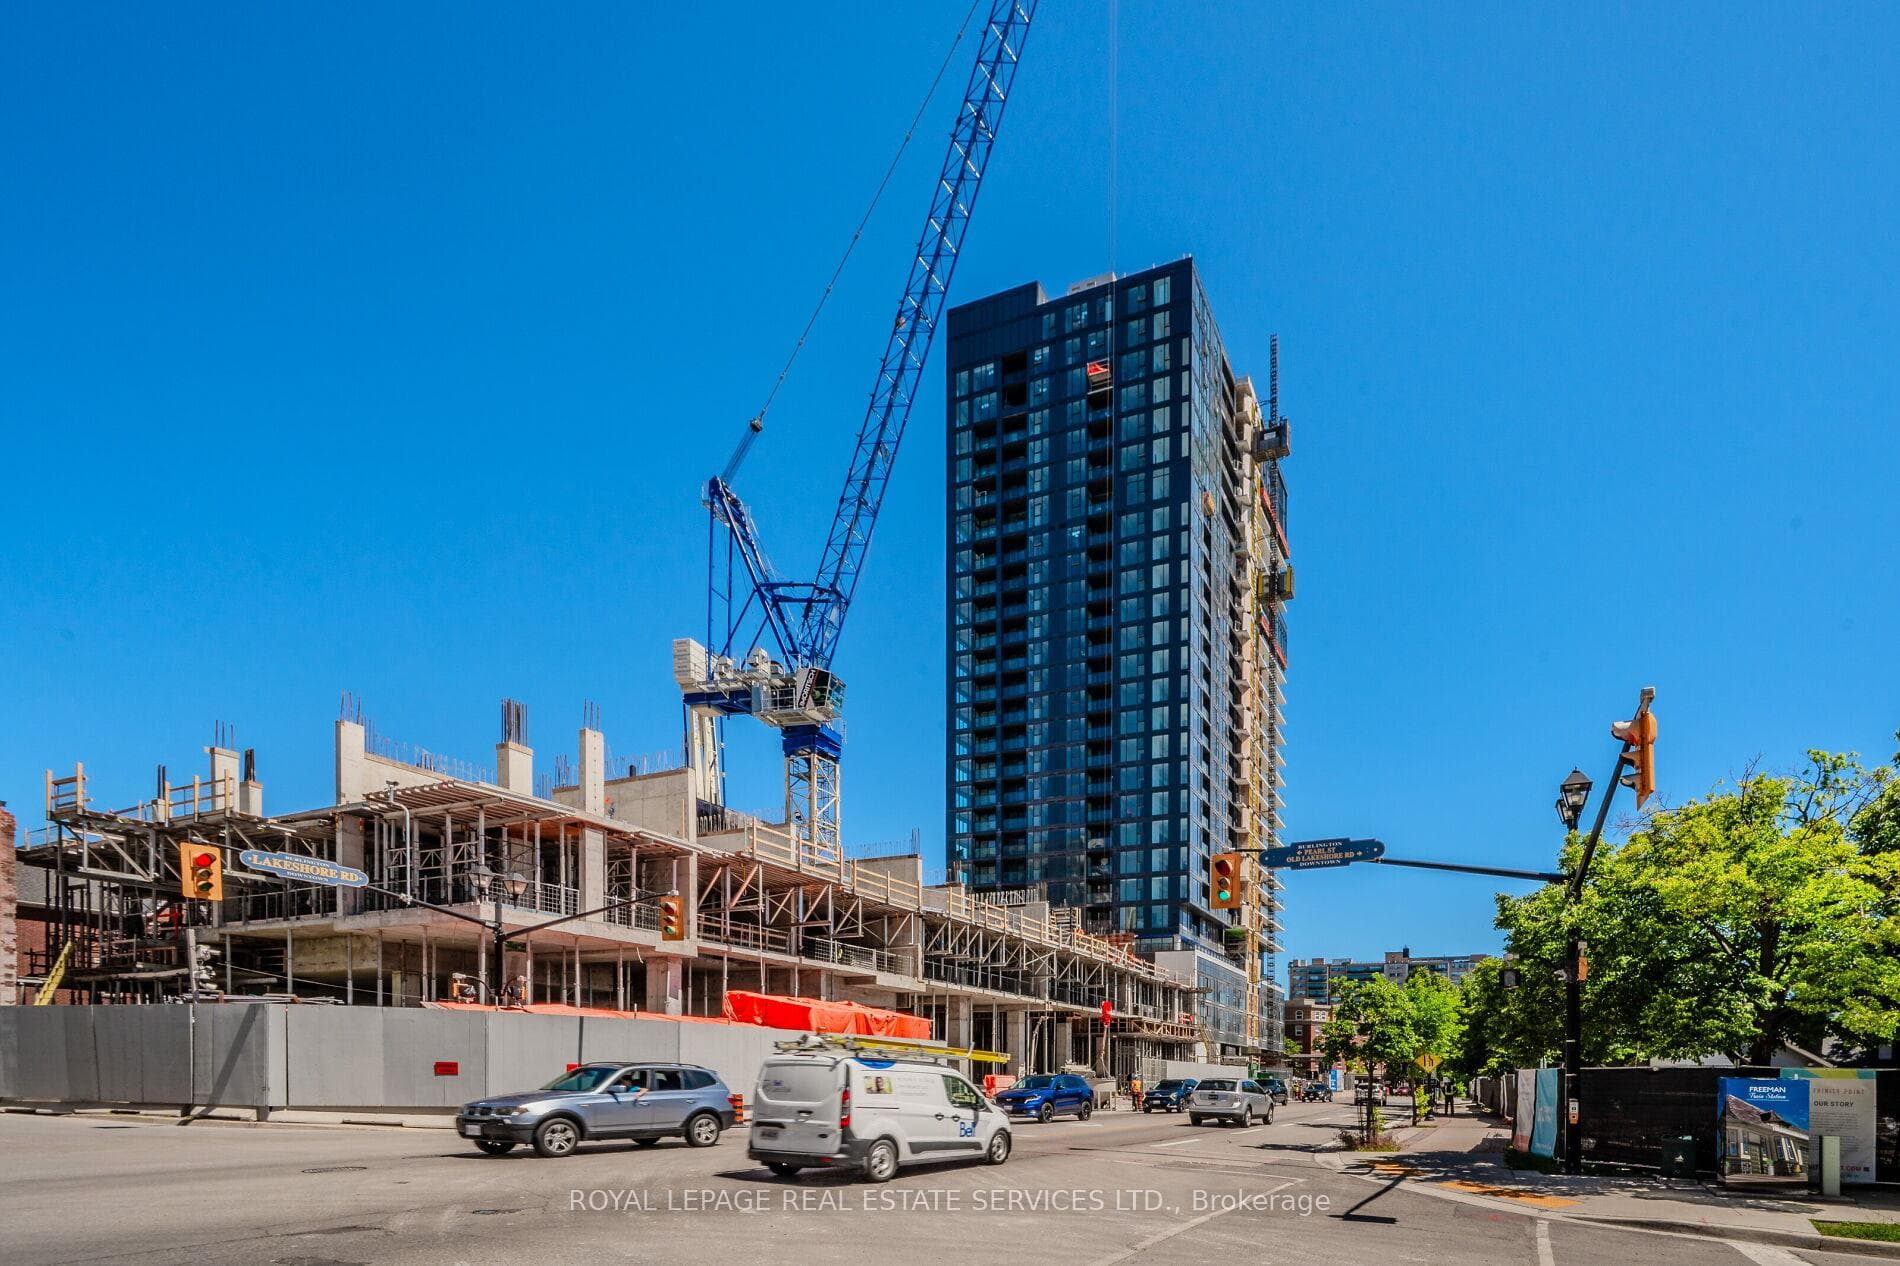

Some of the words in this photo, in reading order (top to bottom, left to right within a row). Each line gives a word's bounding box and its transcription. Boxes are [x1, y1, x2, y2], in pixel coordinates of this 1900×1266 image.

[1298, 842, 1343, 850] BURLINGTON
[285, 855, 330, 868] BURLINGTON
[1302, 852, 1343, 861] LAKESHORE
[252, 854, 338, 879] LAKESHORE
[340, 870, 359, 881] RD
[286, 870, 329, 882] DOWNTOWN
